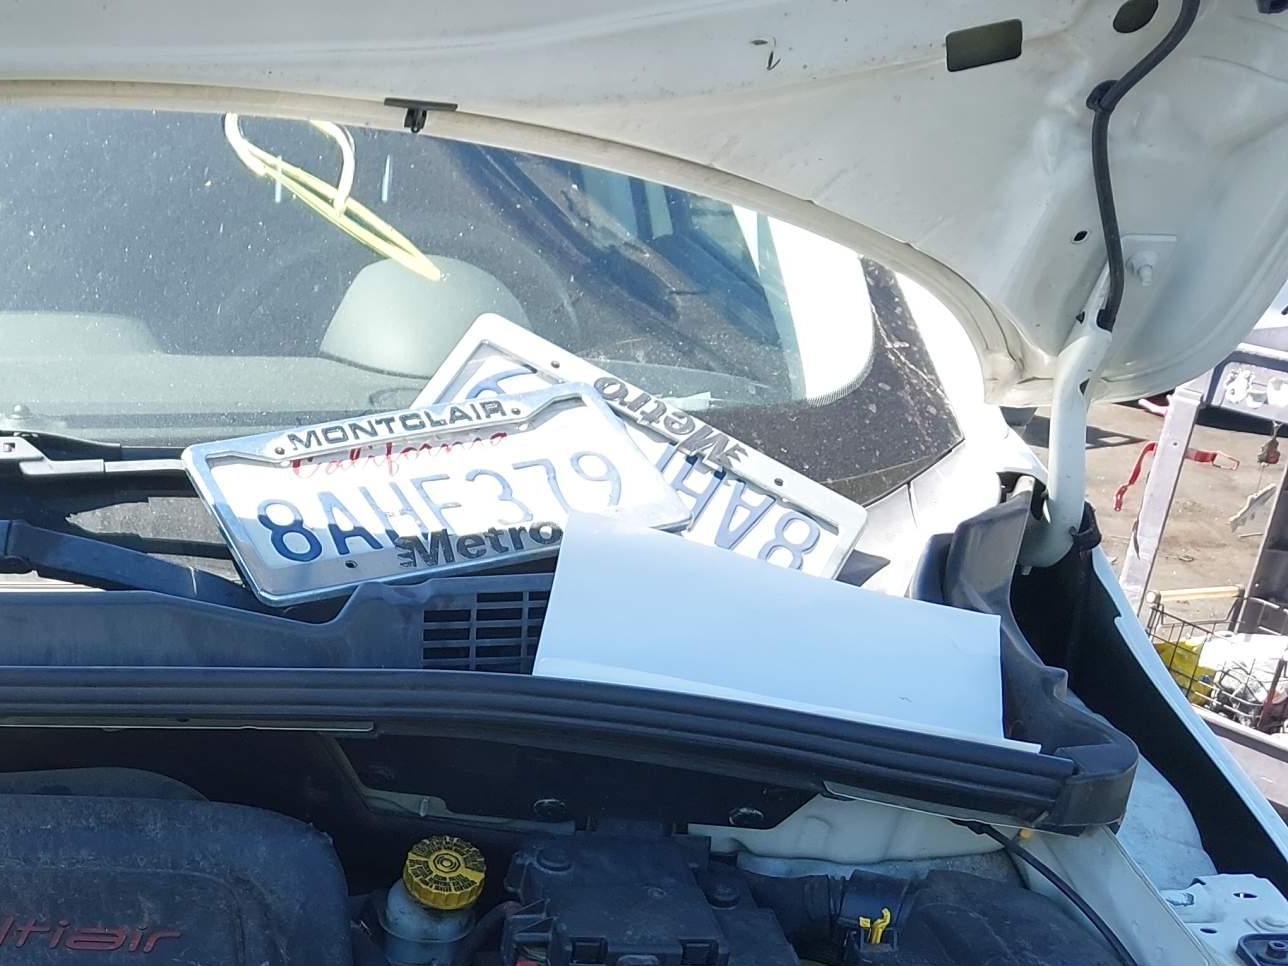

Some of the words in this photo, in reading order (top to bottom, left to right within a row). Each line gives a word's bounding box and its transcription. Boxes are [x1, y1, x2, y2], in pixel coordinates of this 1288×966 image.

[287, 400, 507, 451] MONTCLAIR
[594, 377, 740, 466] Metro
[257, 451, 622, 563] 8AHF379
[402, 520, 564, 567] Metro
